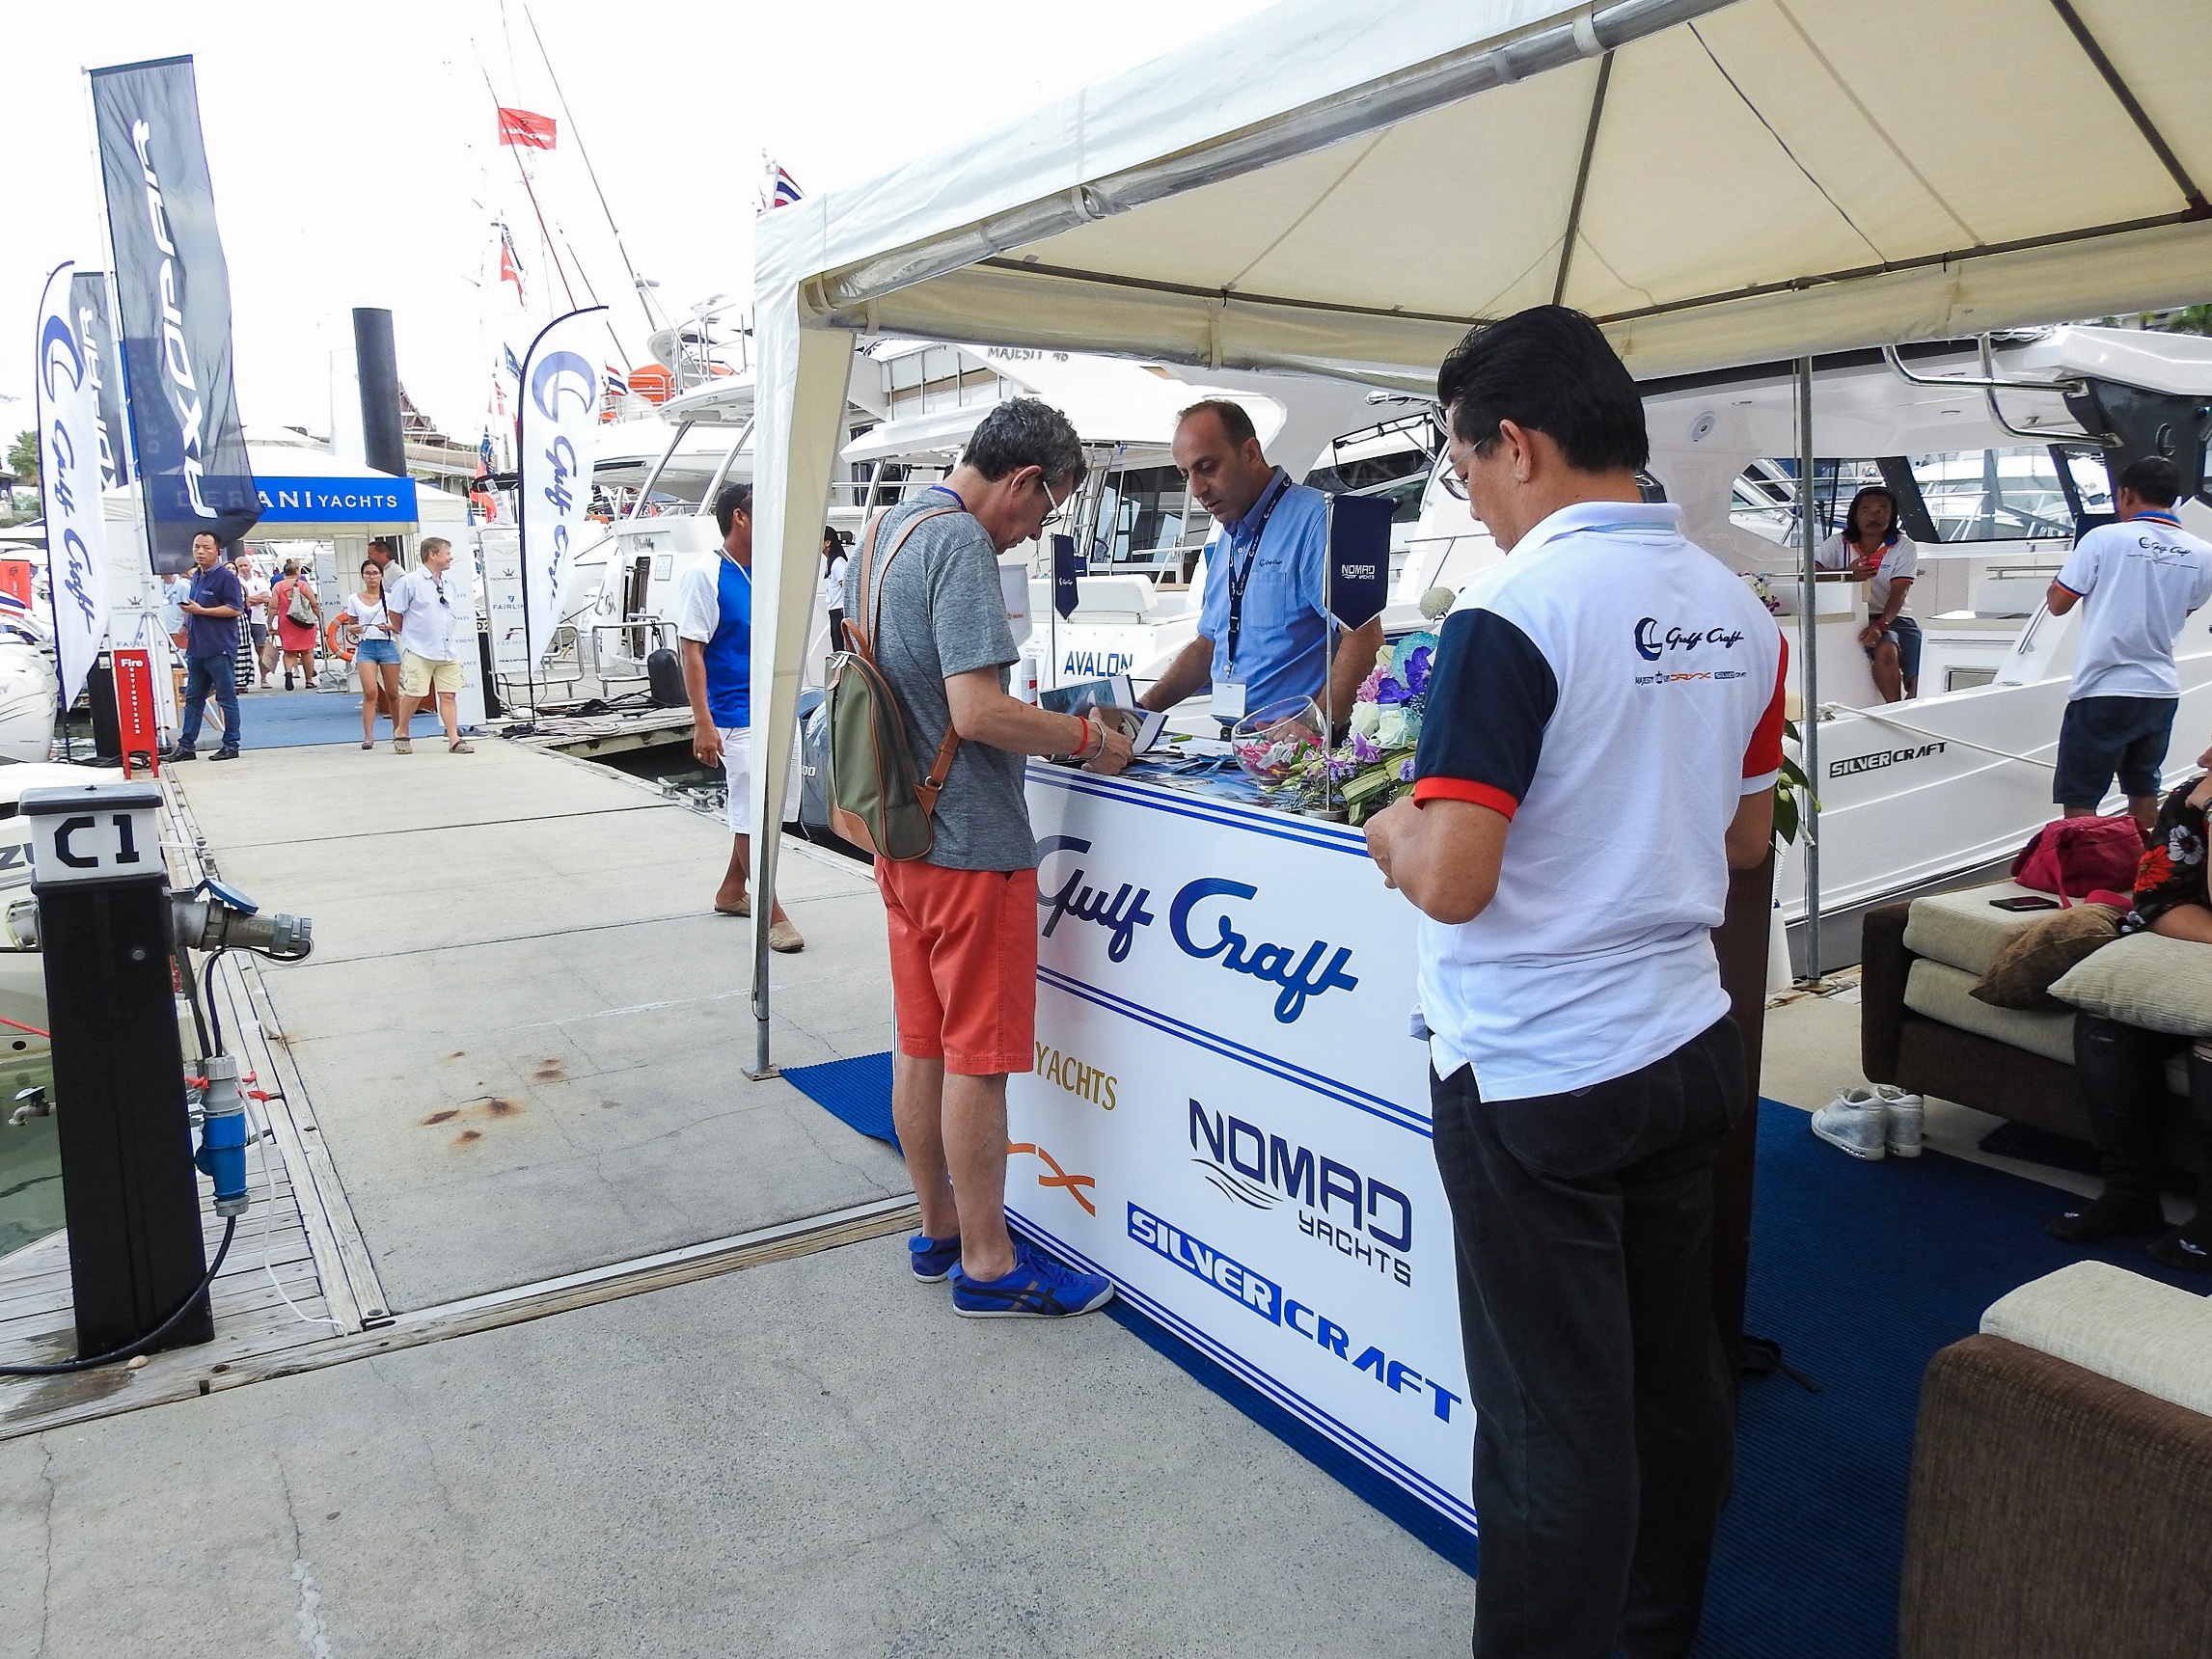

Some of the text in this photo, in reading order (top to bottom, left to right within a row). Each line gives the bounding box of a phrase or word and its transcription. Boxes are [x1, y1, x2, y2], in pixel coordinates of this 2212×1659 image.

[132, 119, 217, 519] AXOPAR
[79, 307, 117, 492] XOPAR
[317, 495, 397, 508] YACHTS
[545, 435, 577, 516] Gulf
[52, 420, 95, 634] Gulf Craft
[1342, 564, 1375, 575] NOMAD
[121, 658, 144, 667] Fire
[1064, 651, 1133, 677] AVALON
[1665, 626, 1745, 651] Gulf Craft
[1831, 742, 1947, 776] SILVER CRAFT
[54, 814, 140, 868] C1
[1037, 834, 1359, 1023] Gulf Craft
[1035, 1042, 1118, 1110] YACHTS
[1189, 1098, 1411, 1253] NOMAD
[1298, 1209, 1411, 1288] YACHTS
[1131, 1210, 1461, 1424] SILVER CRAFT
